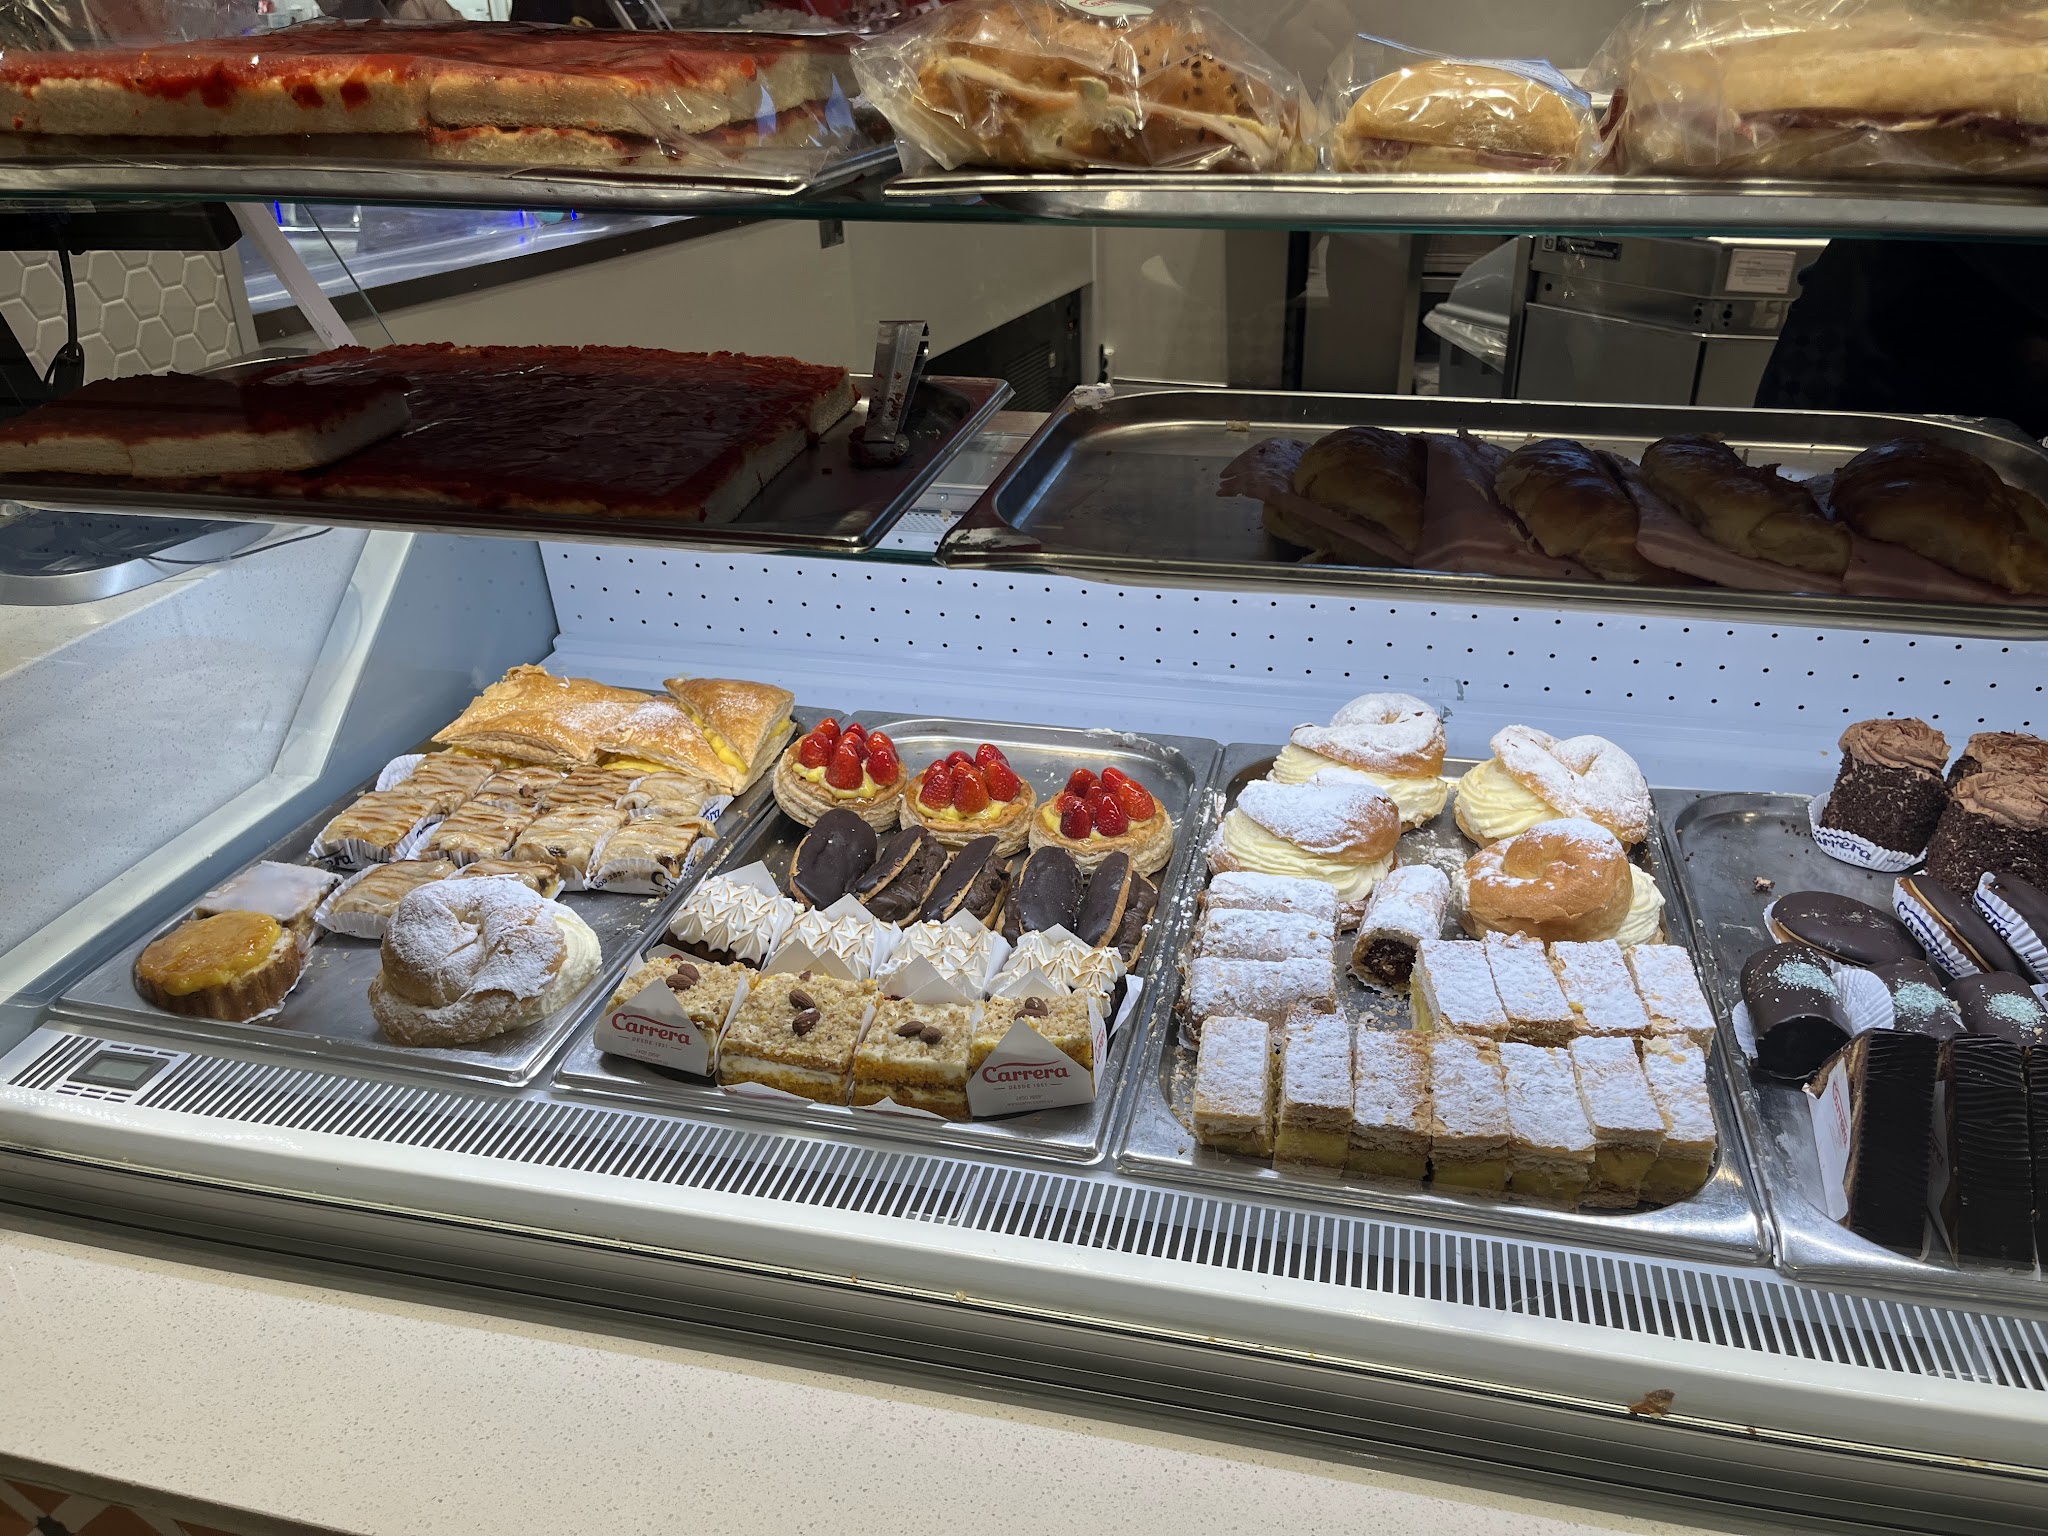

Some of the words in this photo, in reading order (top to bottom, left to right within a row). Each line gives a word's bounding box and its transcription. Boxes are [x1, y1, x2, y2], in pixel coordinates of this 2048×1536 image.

[612, 1012, 692, 1046] Carrera
[631, 1036, 653, 1046] DESDE
[982, 1060, 1071, 1083] Carrera
